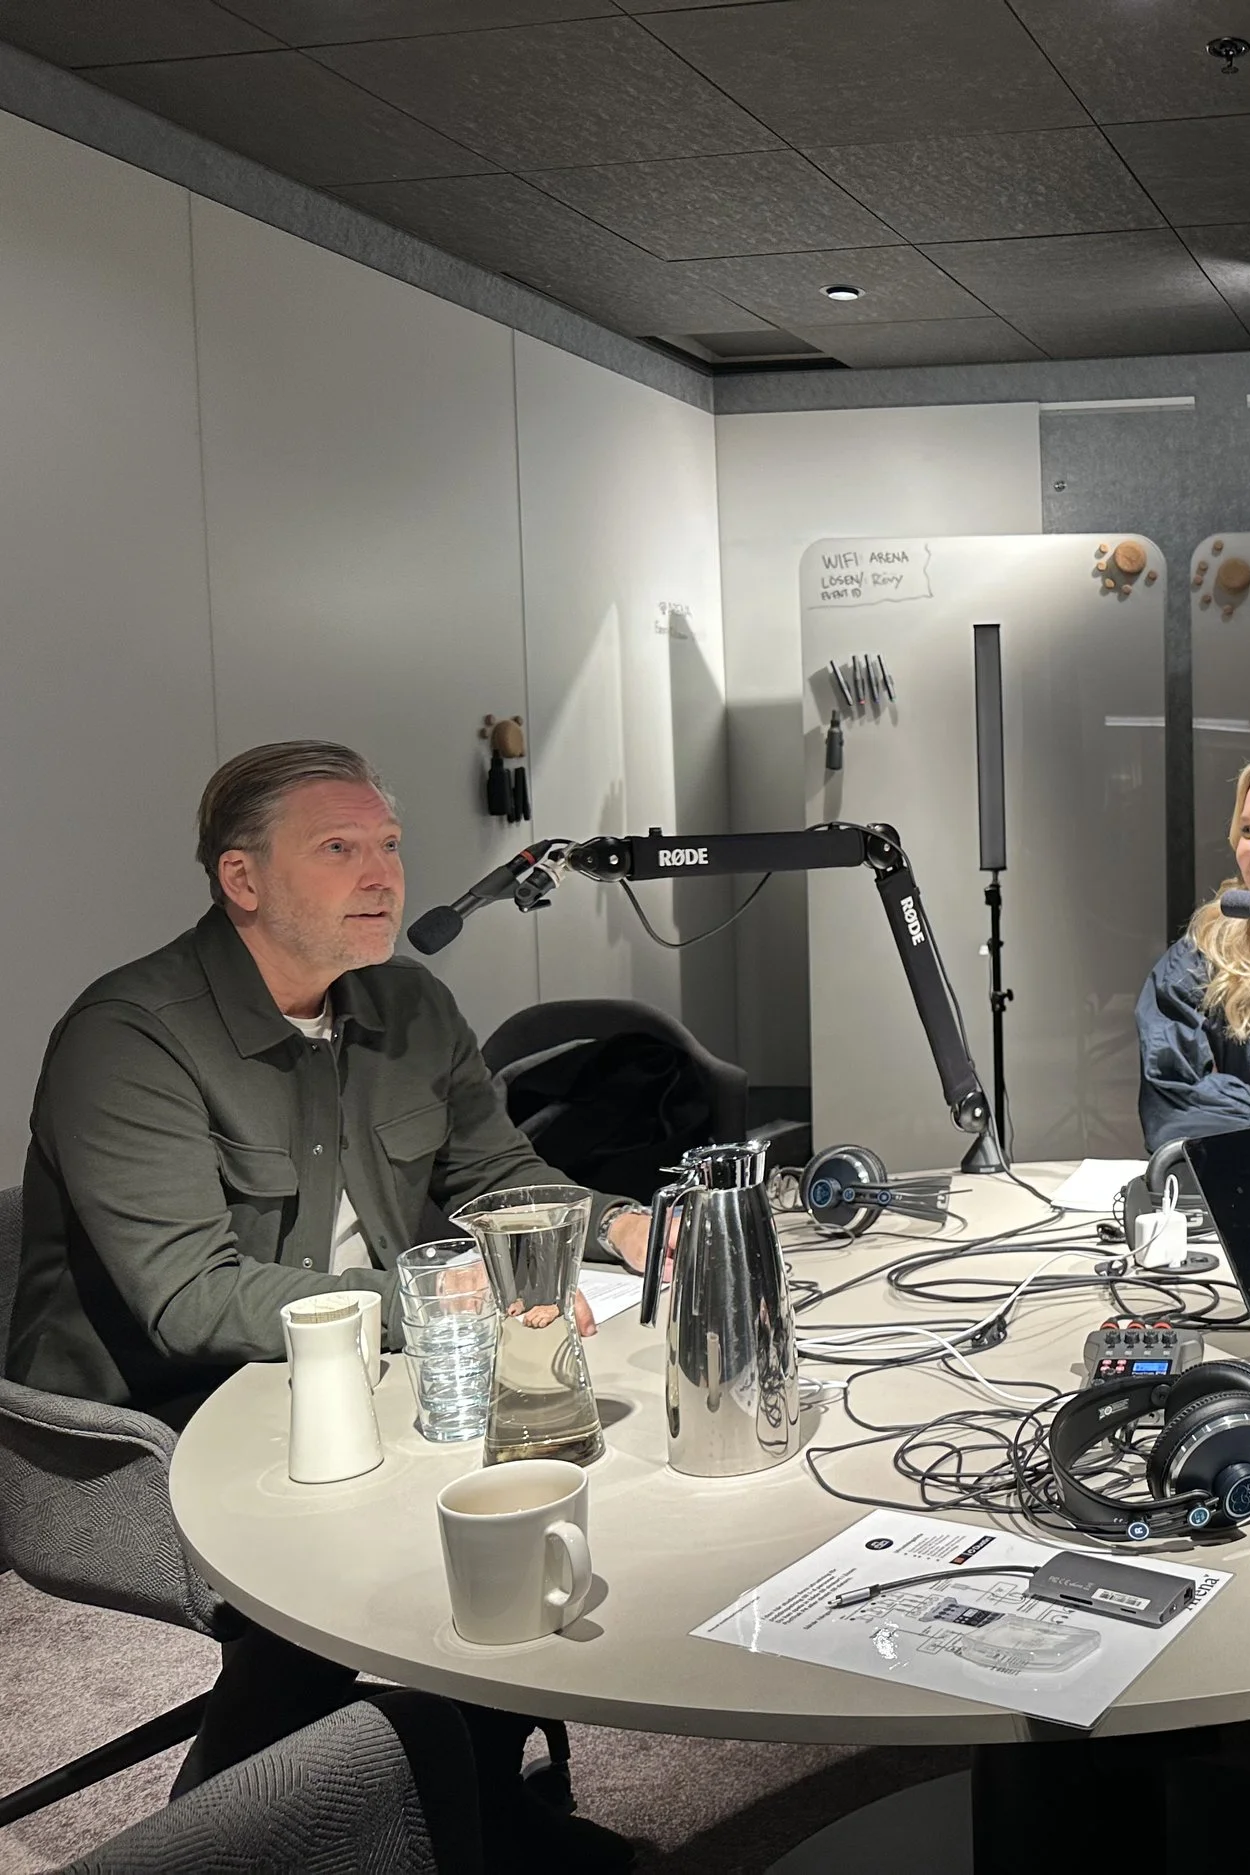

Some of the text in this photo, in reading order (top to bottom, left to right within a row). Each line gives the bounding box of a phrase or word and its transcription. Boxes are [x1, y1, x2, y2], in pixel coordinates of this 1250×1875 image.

[822, 551, 909, 569] WIFI ARENA
[659, 848, 709, 867] RØDE
[900, 896, 925, 946] RØDE
